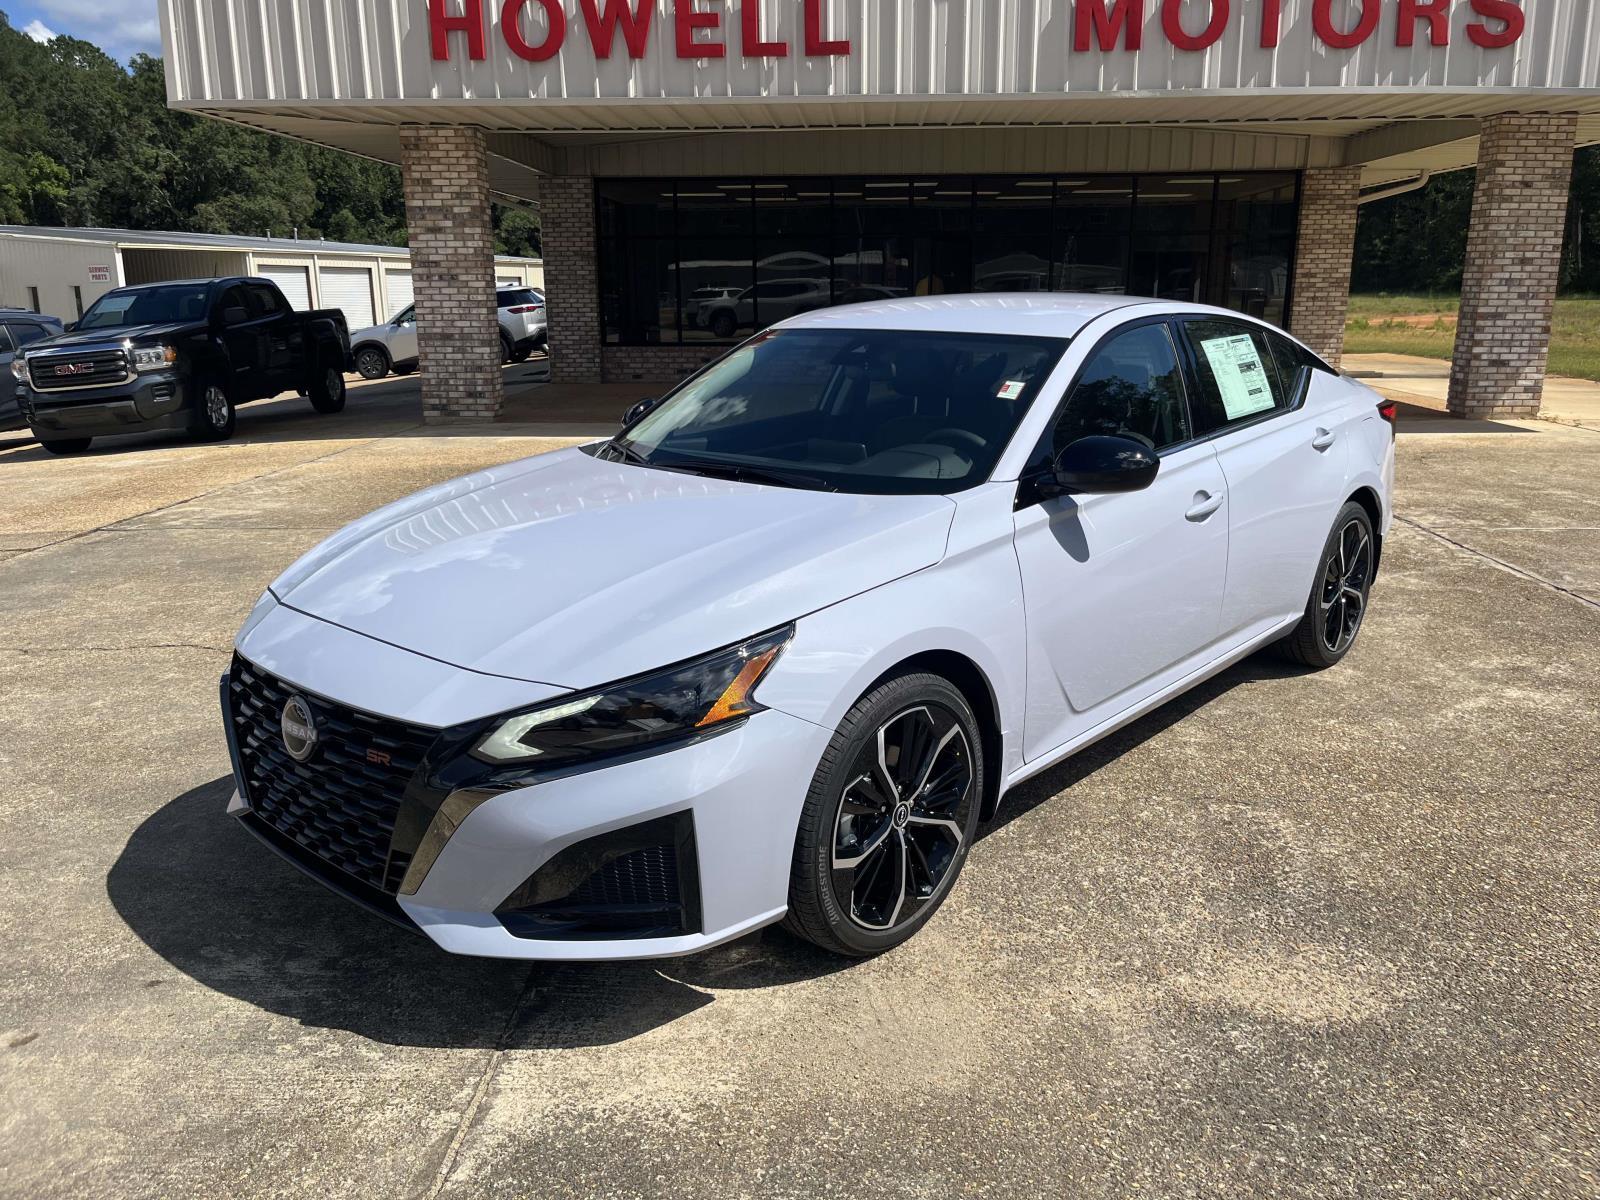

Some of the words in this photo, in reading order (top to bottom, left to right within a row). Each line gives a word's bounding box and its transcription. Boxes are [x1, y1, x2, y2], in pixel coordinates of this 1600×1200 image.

[428, 0, 851, 62] HOWELL
[55, 363, 94, 375] GMC
[282, 720, 316, 741] SSAN
[366, 748, 391, 767] SR
